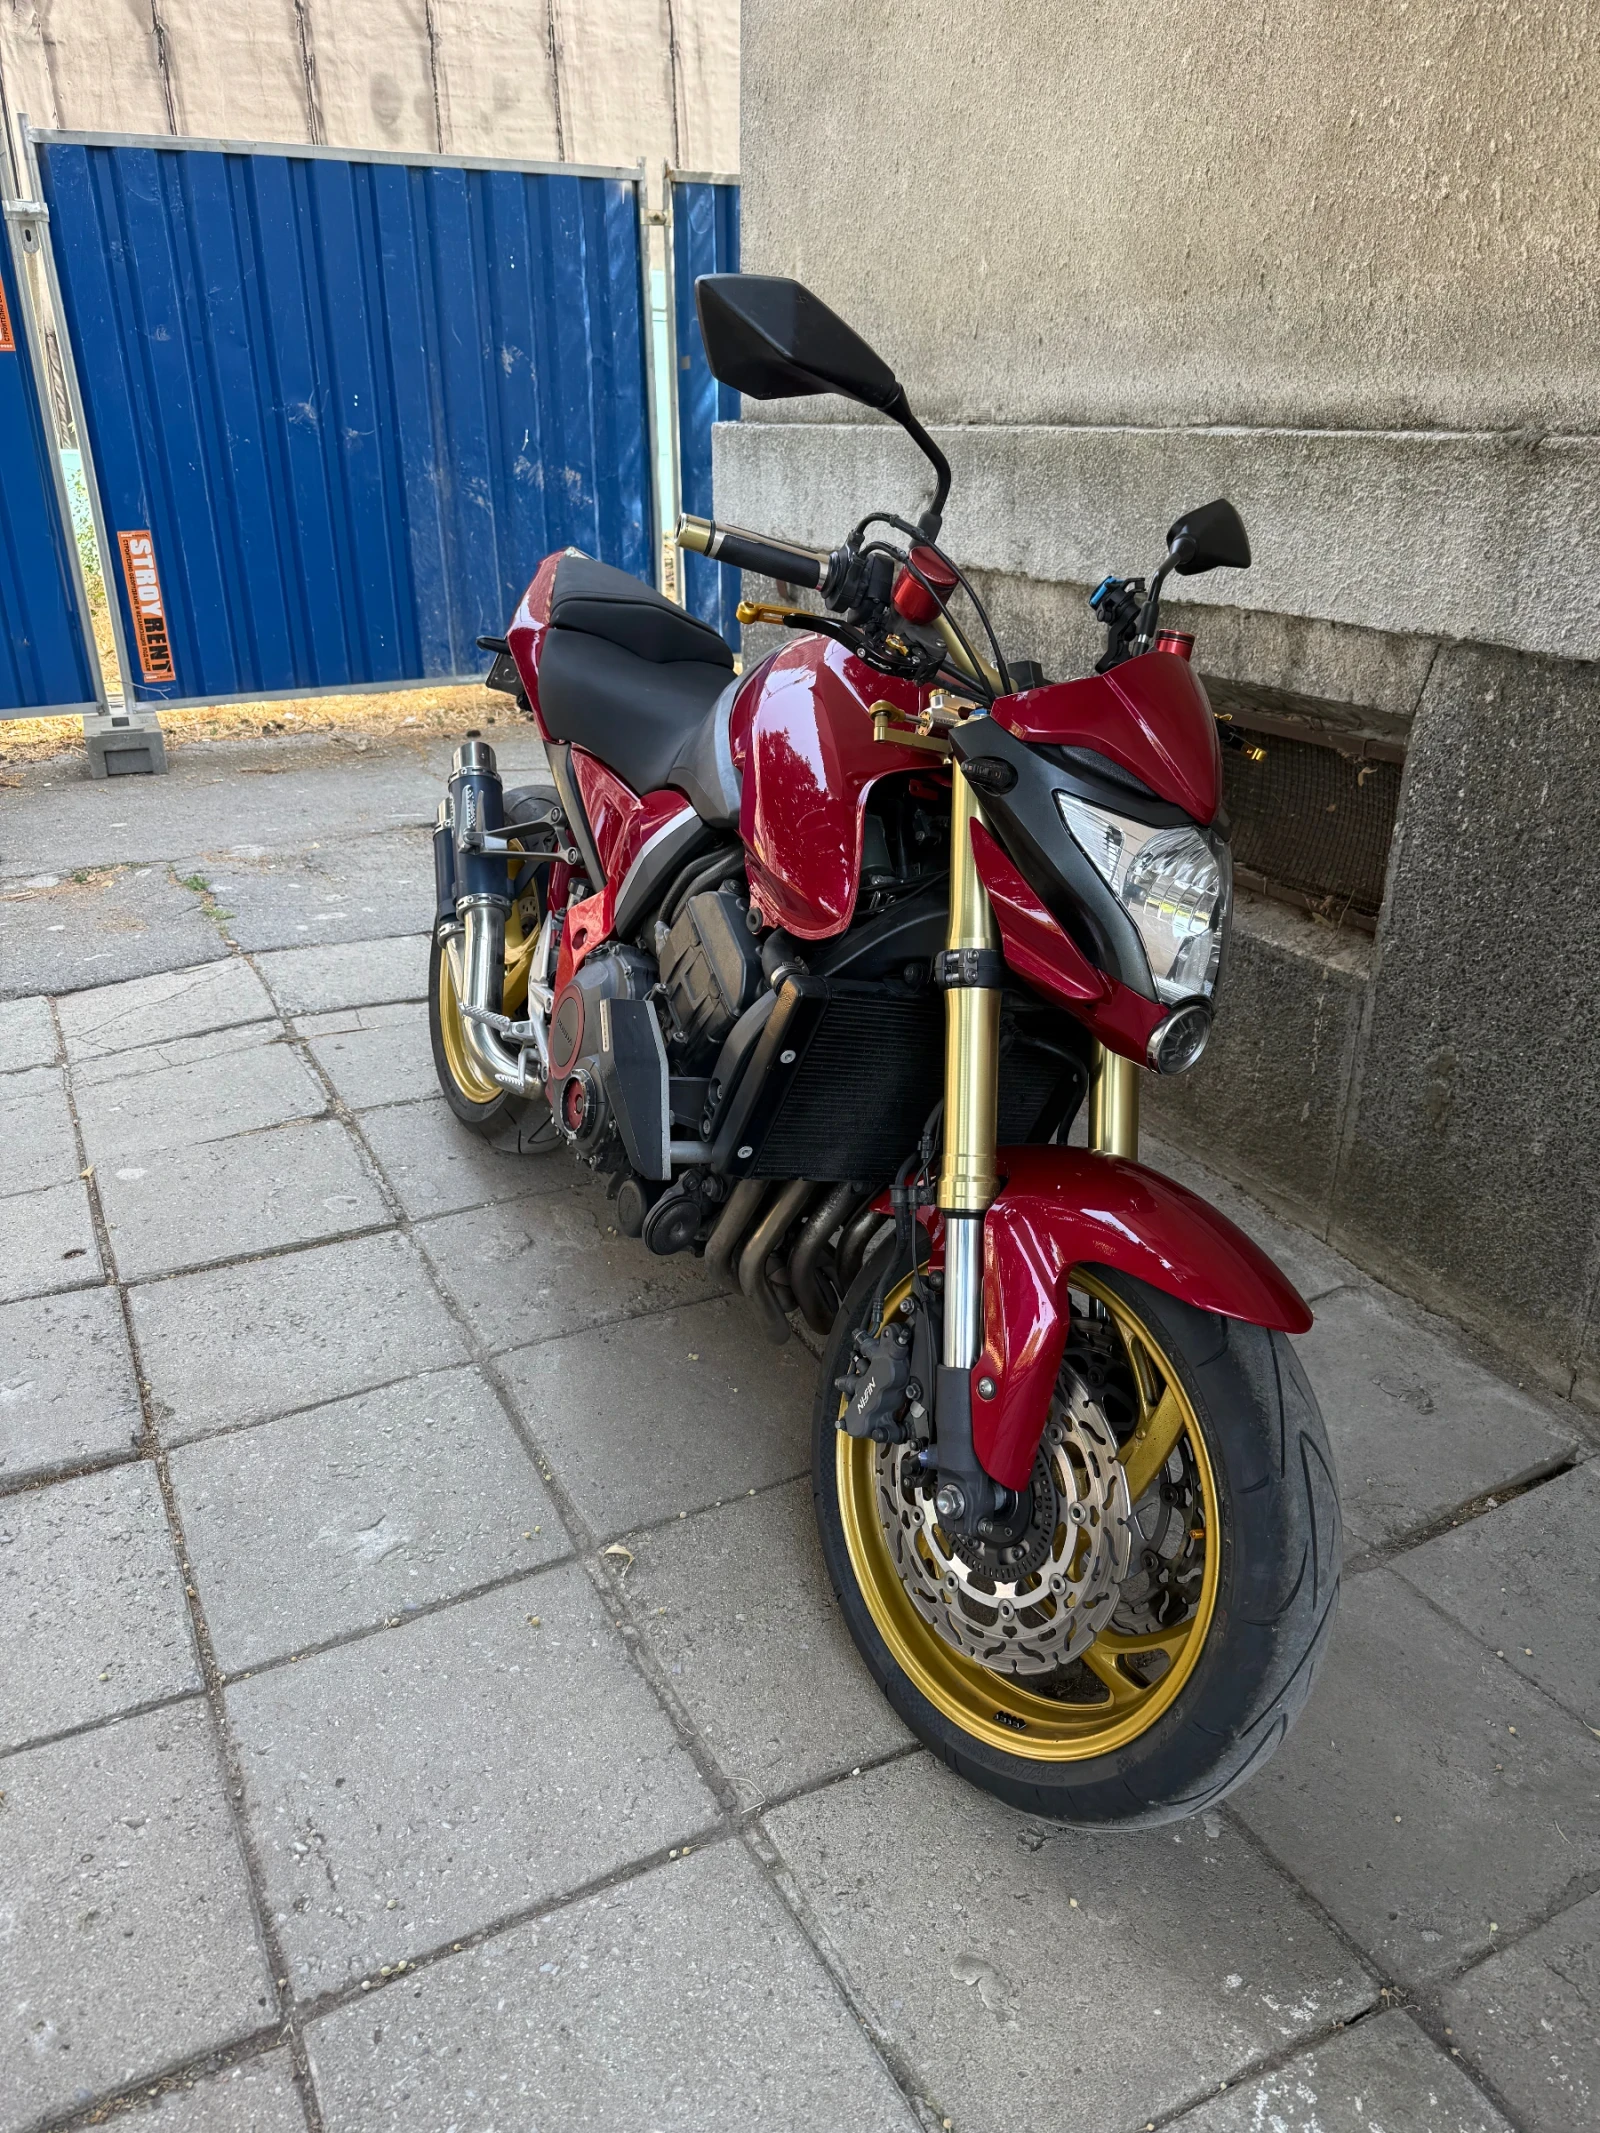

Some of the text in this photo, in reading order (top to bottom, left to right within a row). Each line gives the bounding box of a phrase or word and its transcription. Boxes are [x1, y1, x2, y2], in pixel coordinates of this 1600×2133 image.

[122, 540, 133, 572] СТРОИТЕЛНО
[557, 1017, 573, 1046] HONDA
[857, 1376, 876, 1414] NISSIN
